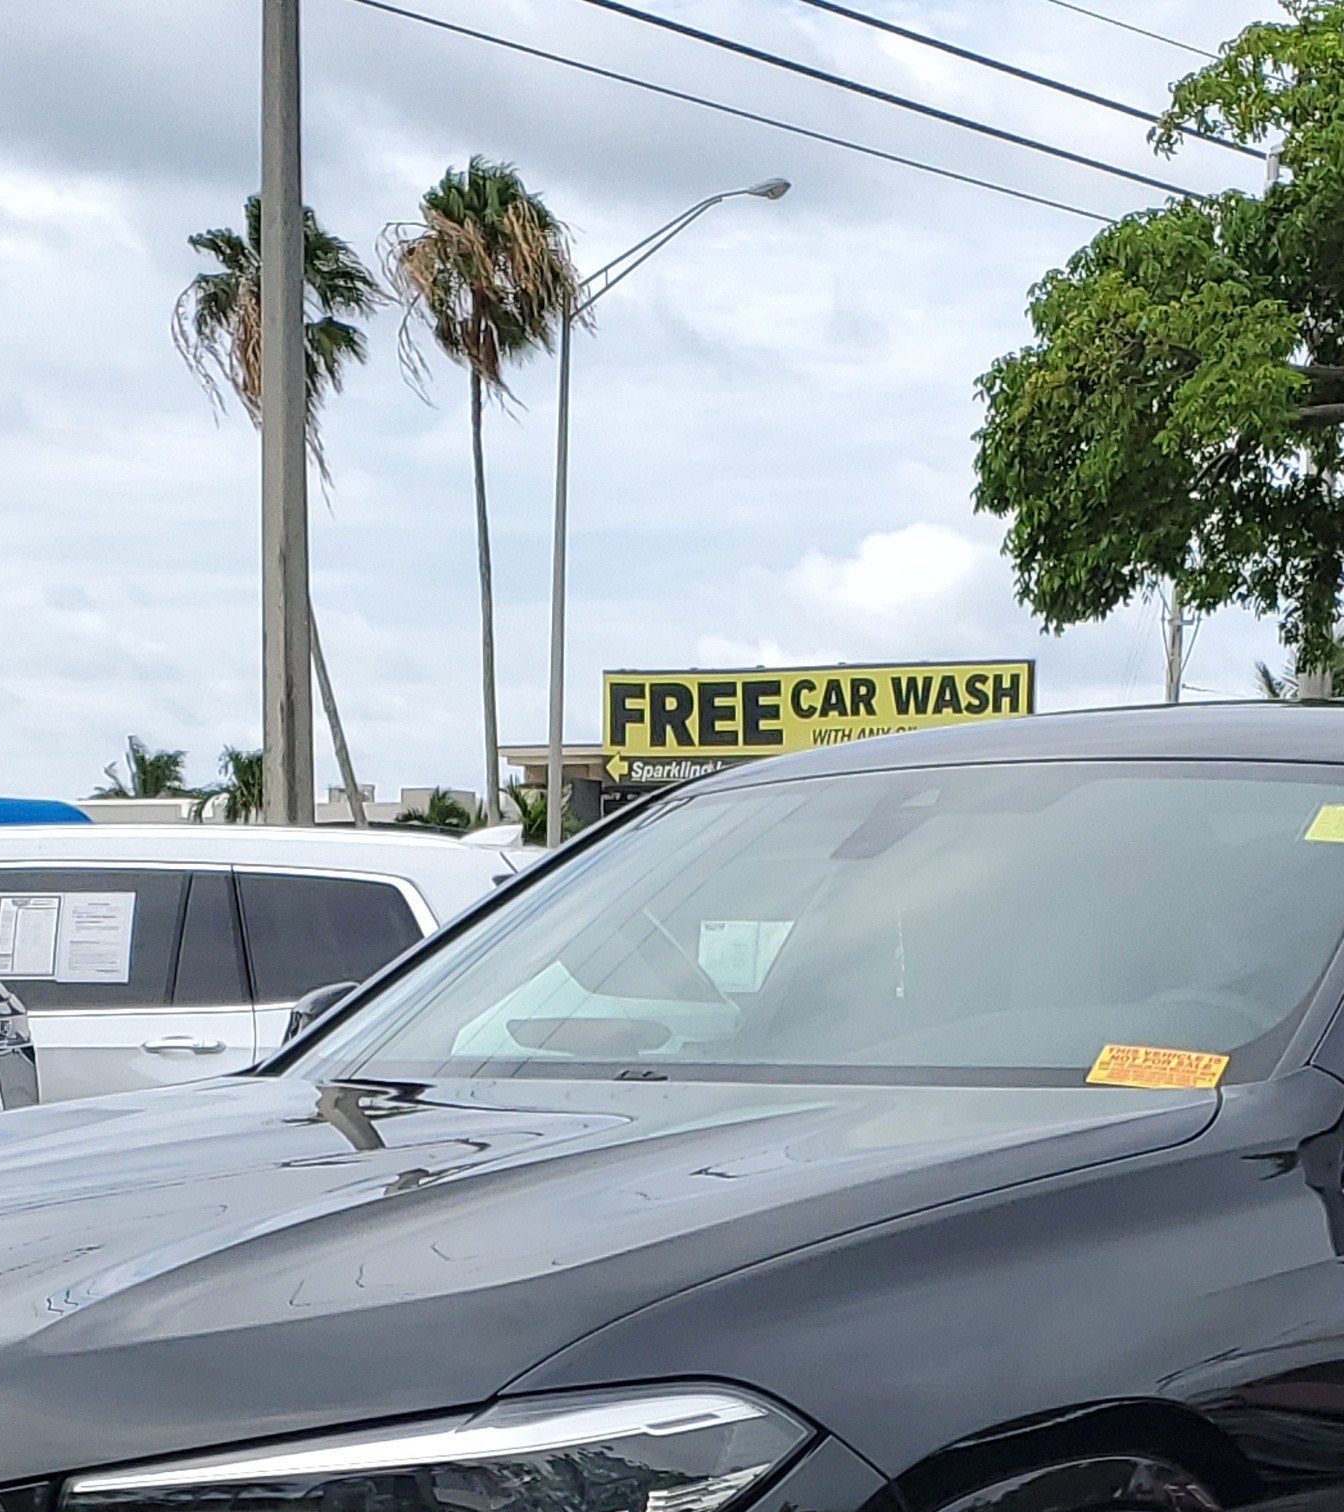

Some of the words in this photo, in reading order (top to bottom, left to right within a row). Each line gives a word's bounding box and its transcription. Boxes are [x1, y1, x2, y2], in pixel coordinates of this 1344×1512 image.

[609, 680, 783, 748] FREE
[790, 677, 877, 719] CAR
[890, 672, 1021, 716] WASH
[812, 727, 852, 746] WITH
[1109, 1048, 1139, 1056] THIS
[1144, 1050, 1203, 1062] VEHICLE
[1110, 1055, 1136, 1063] NOT
[1143, 1057, 1171, 1066] FOR
[1177, 1059, 1211, 1070] SALE
